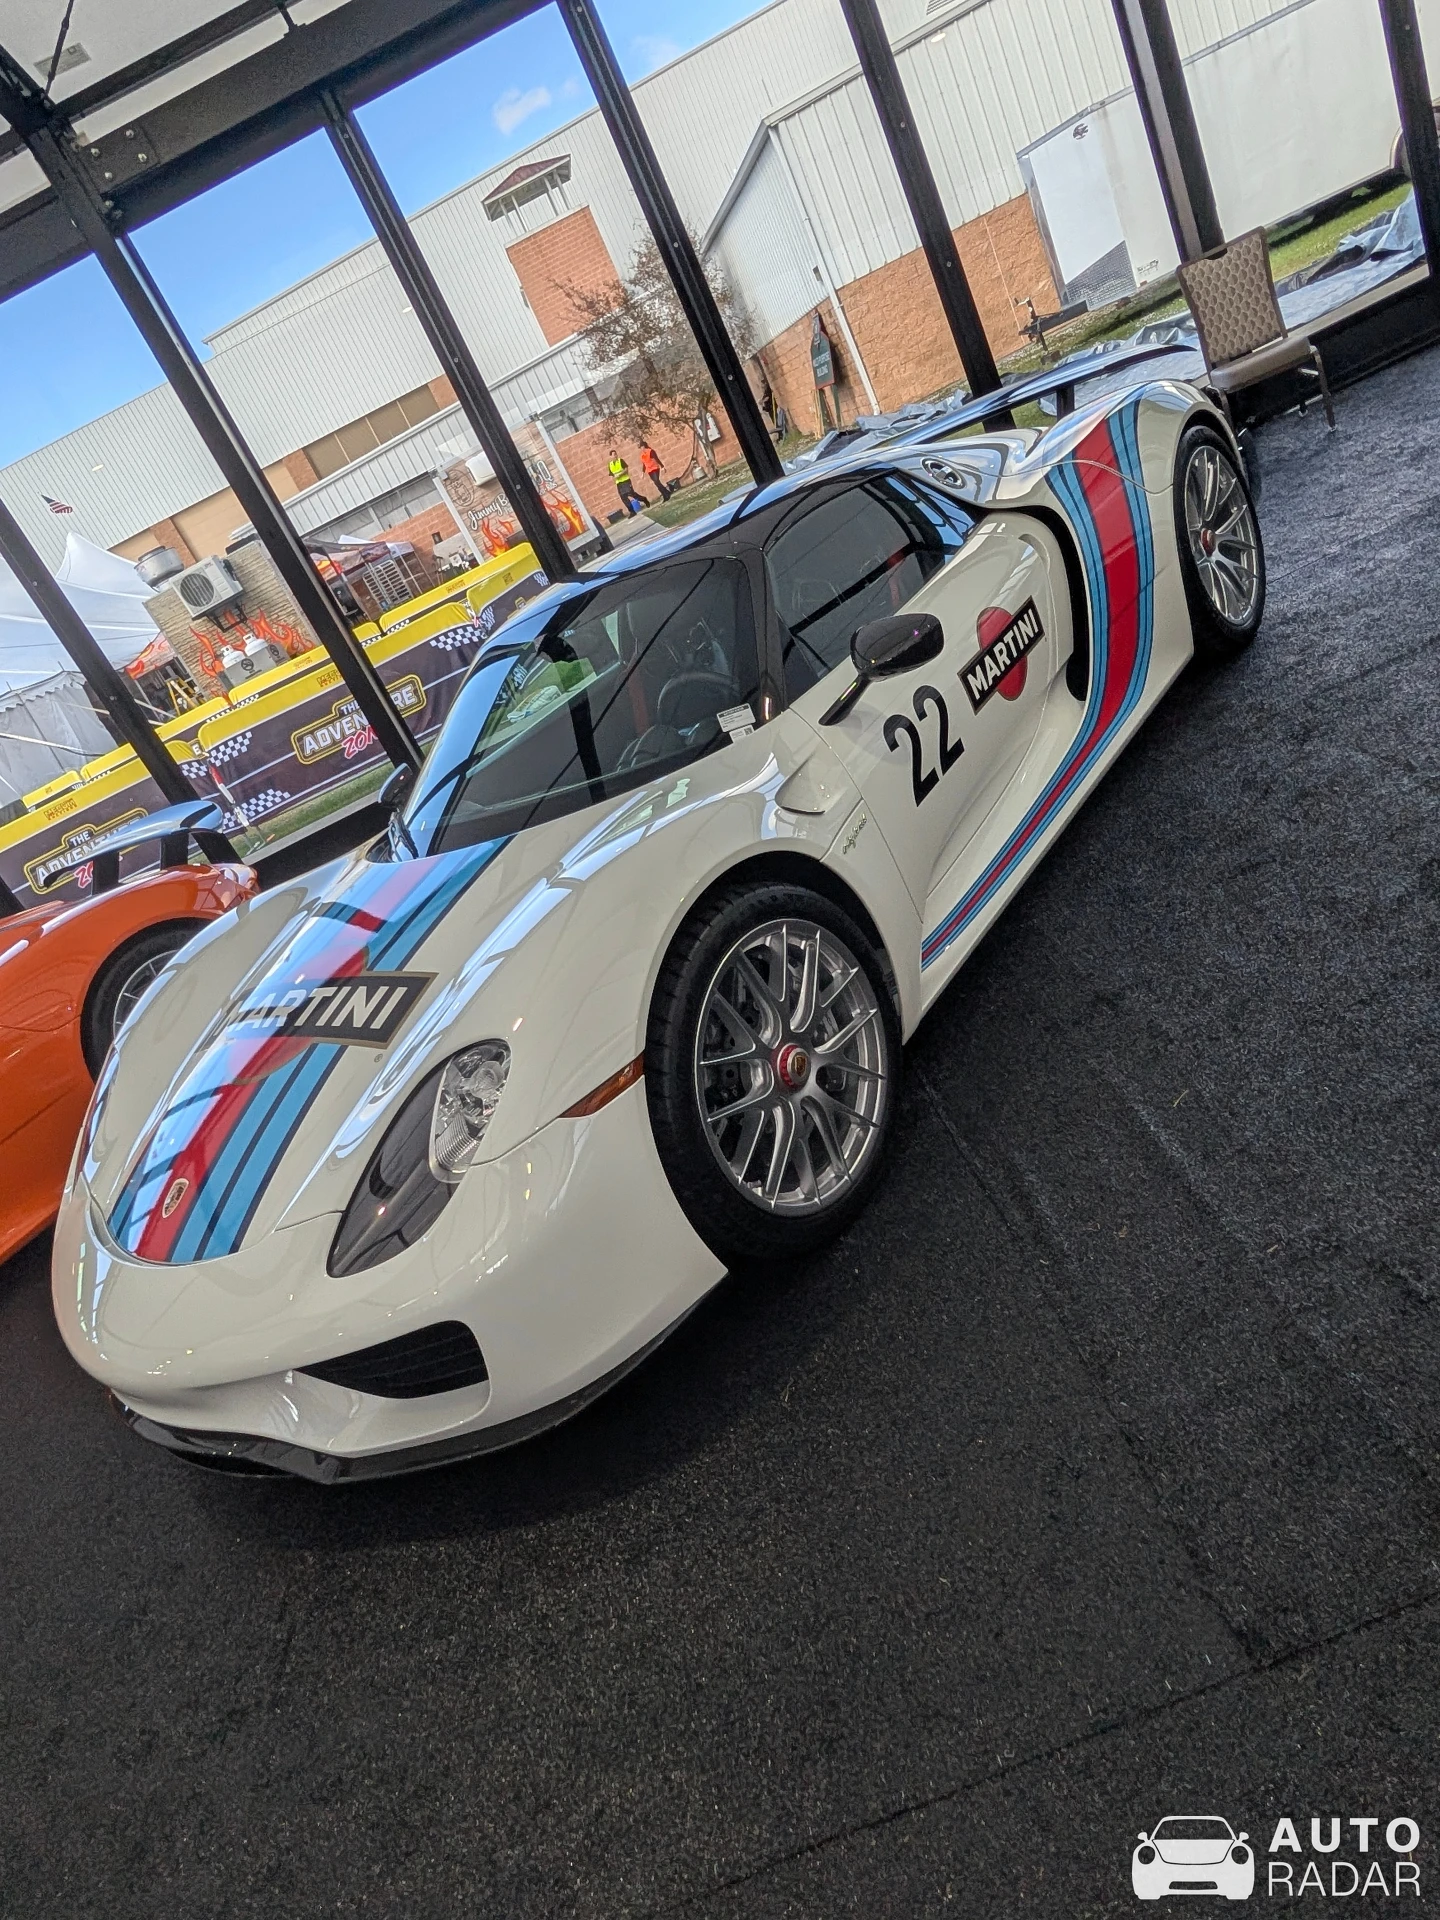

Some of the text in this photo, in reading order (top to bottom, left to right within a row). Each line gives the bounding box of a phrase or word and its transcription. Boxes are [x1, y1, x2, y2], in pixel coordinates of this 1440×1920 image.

[467, 502, 503, 530] Jimmy
[967, 608, 1039, 700] MARTINI
[341, 725, 379, 759] ZON
[883, 685, 965, 807] 22
[69, 831, 91, 846] THE
